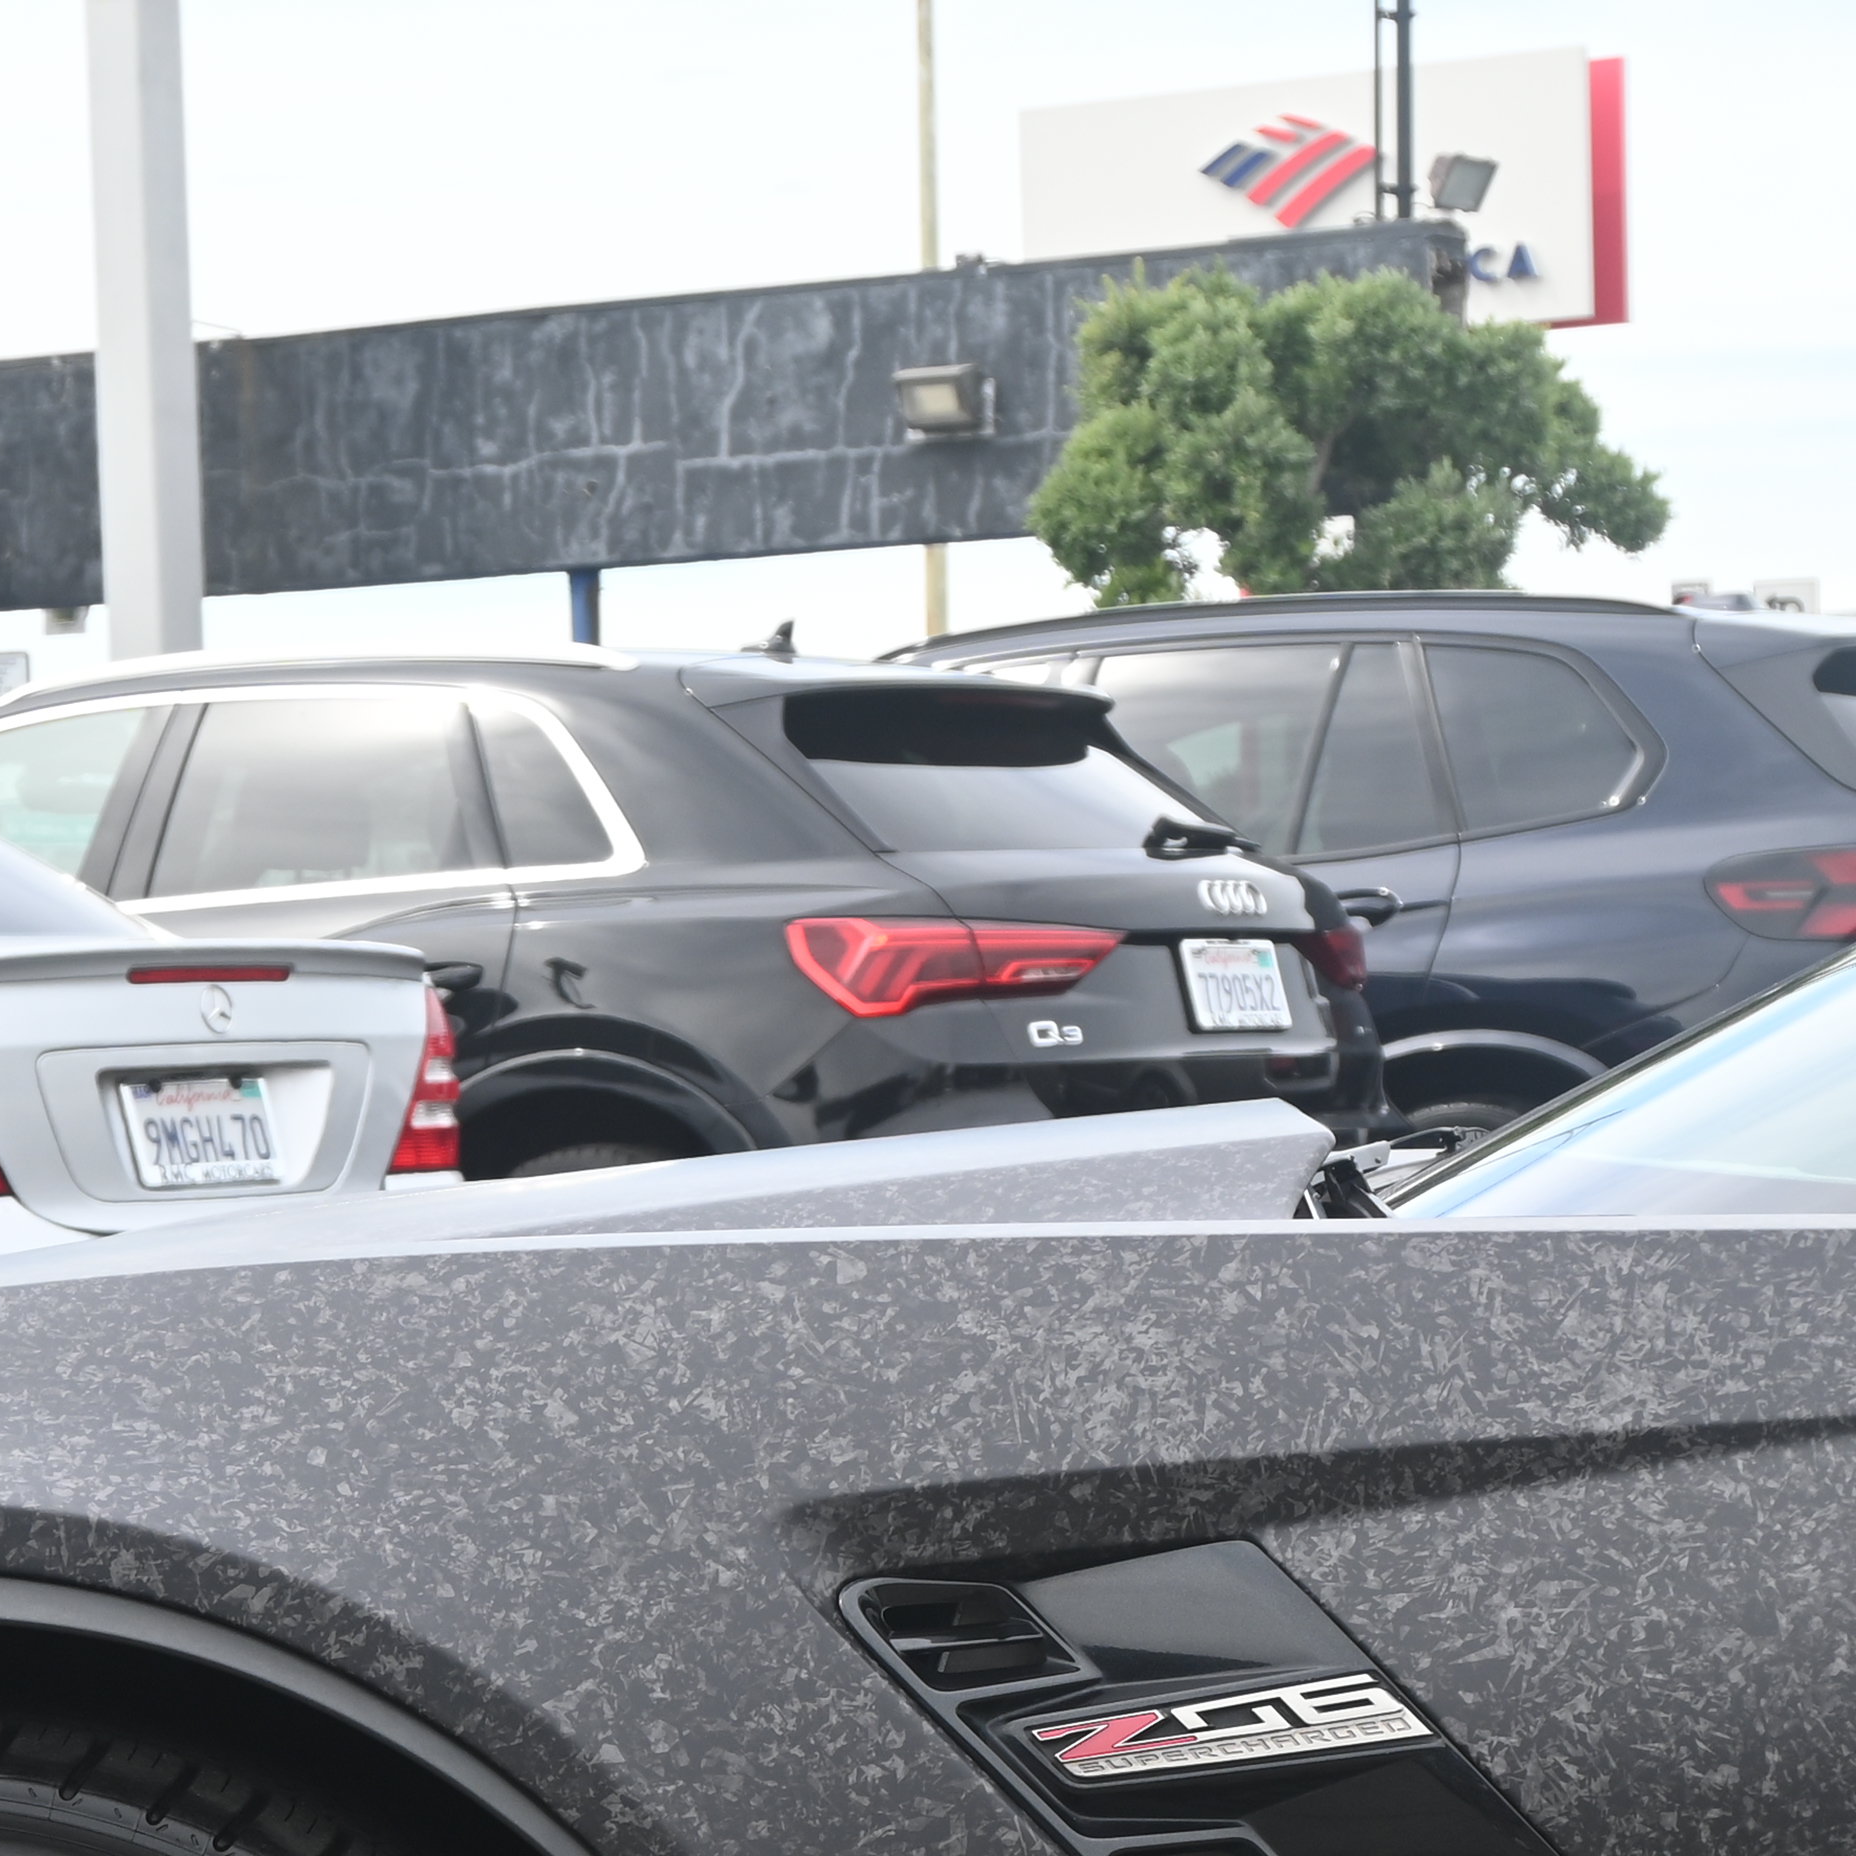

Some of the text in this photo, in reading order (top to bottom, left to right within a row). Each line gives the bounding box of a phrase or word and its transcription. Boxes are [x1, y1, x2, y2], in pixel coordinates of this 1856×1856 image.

[1197, 971, 1281, 1014] 77905X2
[1027, 1020, 1084, 1048] Q3
[145, 1113, 272, 1167] 9MGH470
[1031, 1673, 1407, 1762] Z06
[1075, 1715, 1414, 1775] SUPERCHARGED
